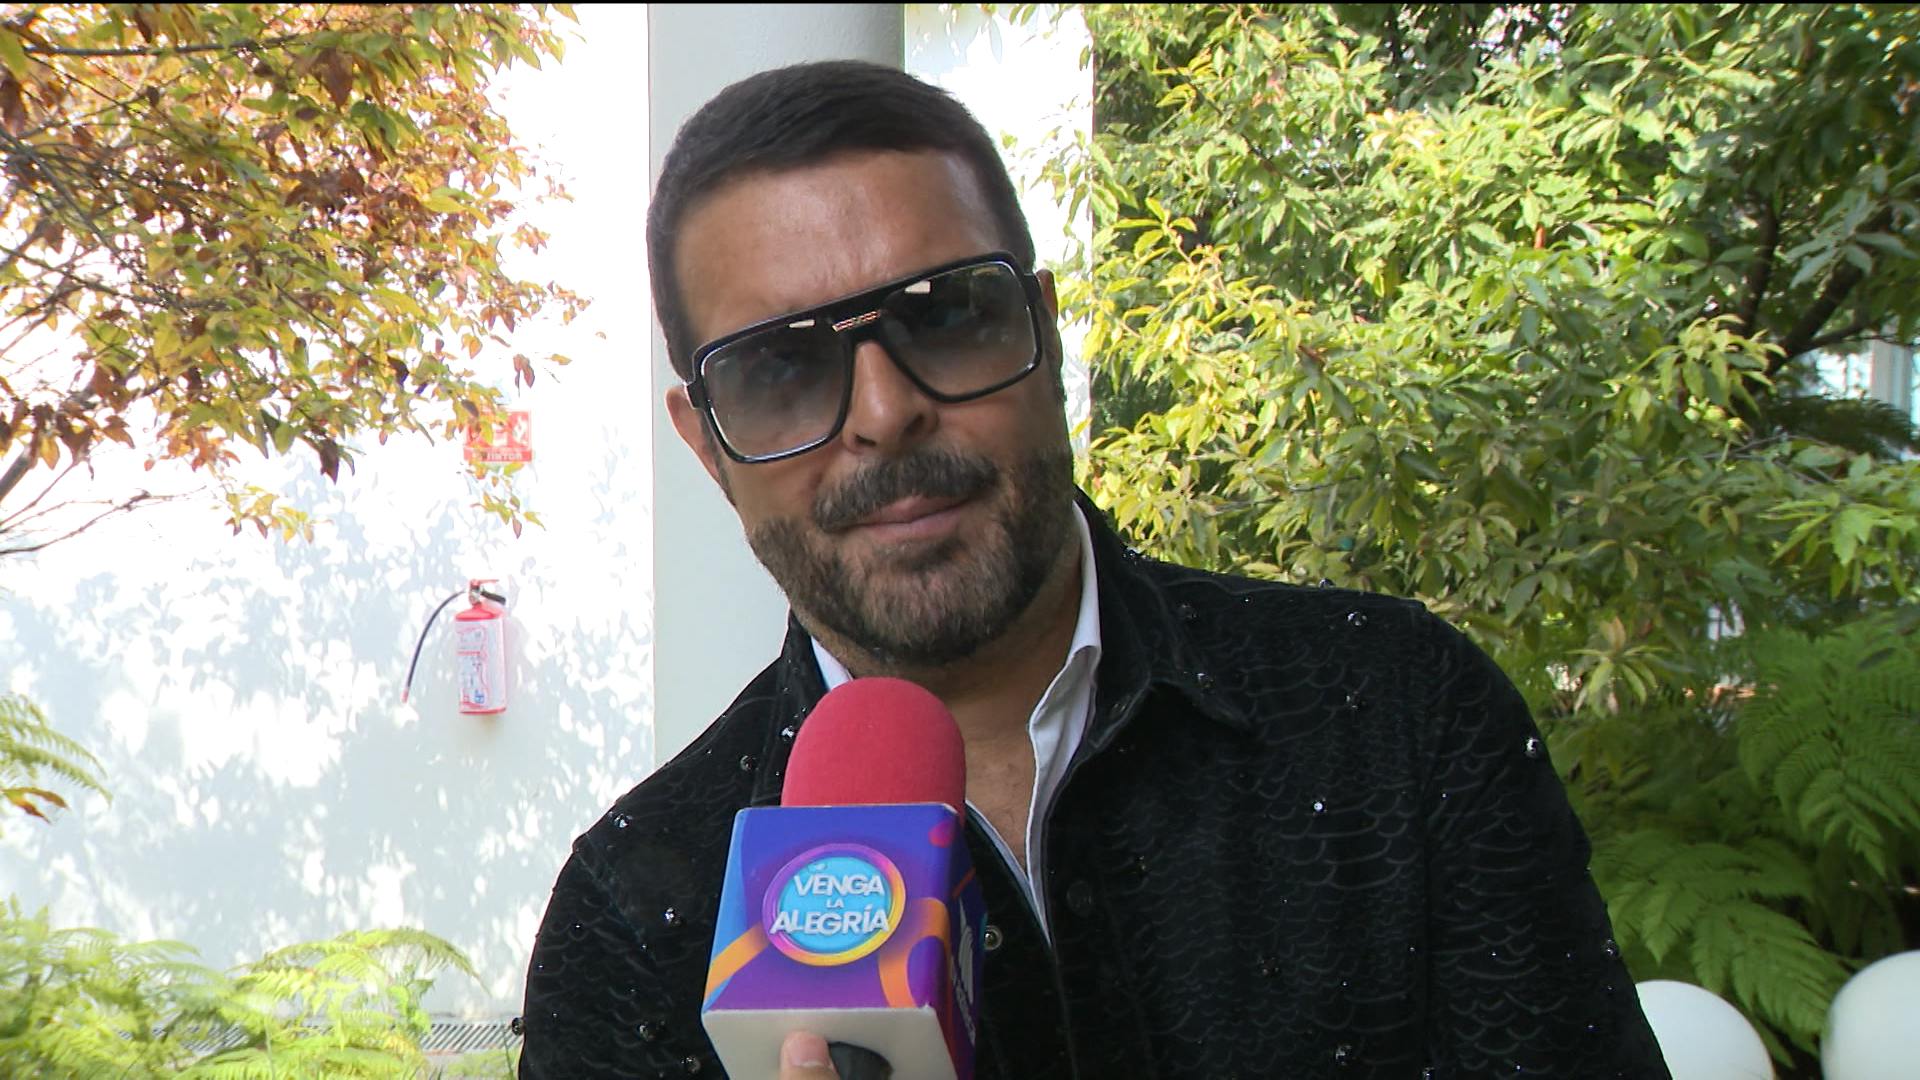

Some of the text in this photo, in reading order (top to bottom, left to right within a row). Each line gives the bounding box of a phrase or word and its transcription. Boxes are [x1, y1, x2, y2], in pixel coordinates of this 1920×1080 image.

[793, 873, 885, 896] VENGA
[825, 898, 844, 908] LA
[769, 904, 889, 936] ALEGRÍA
